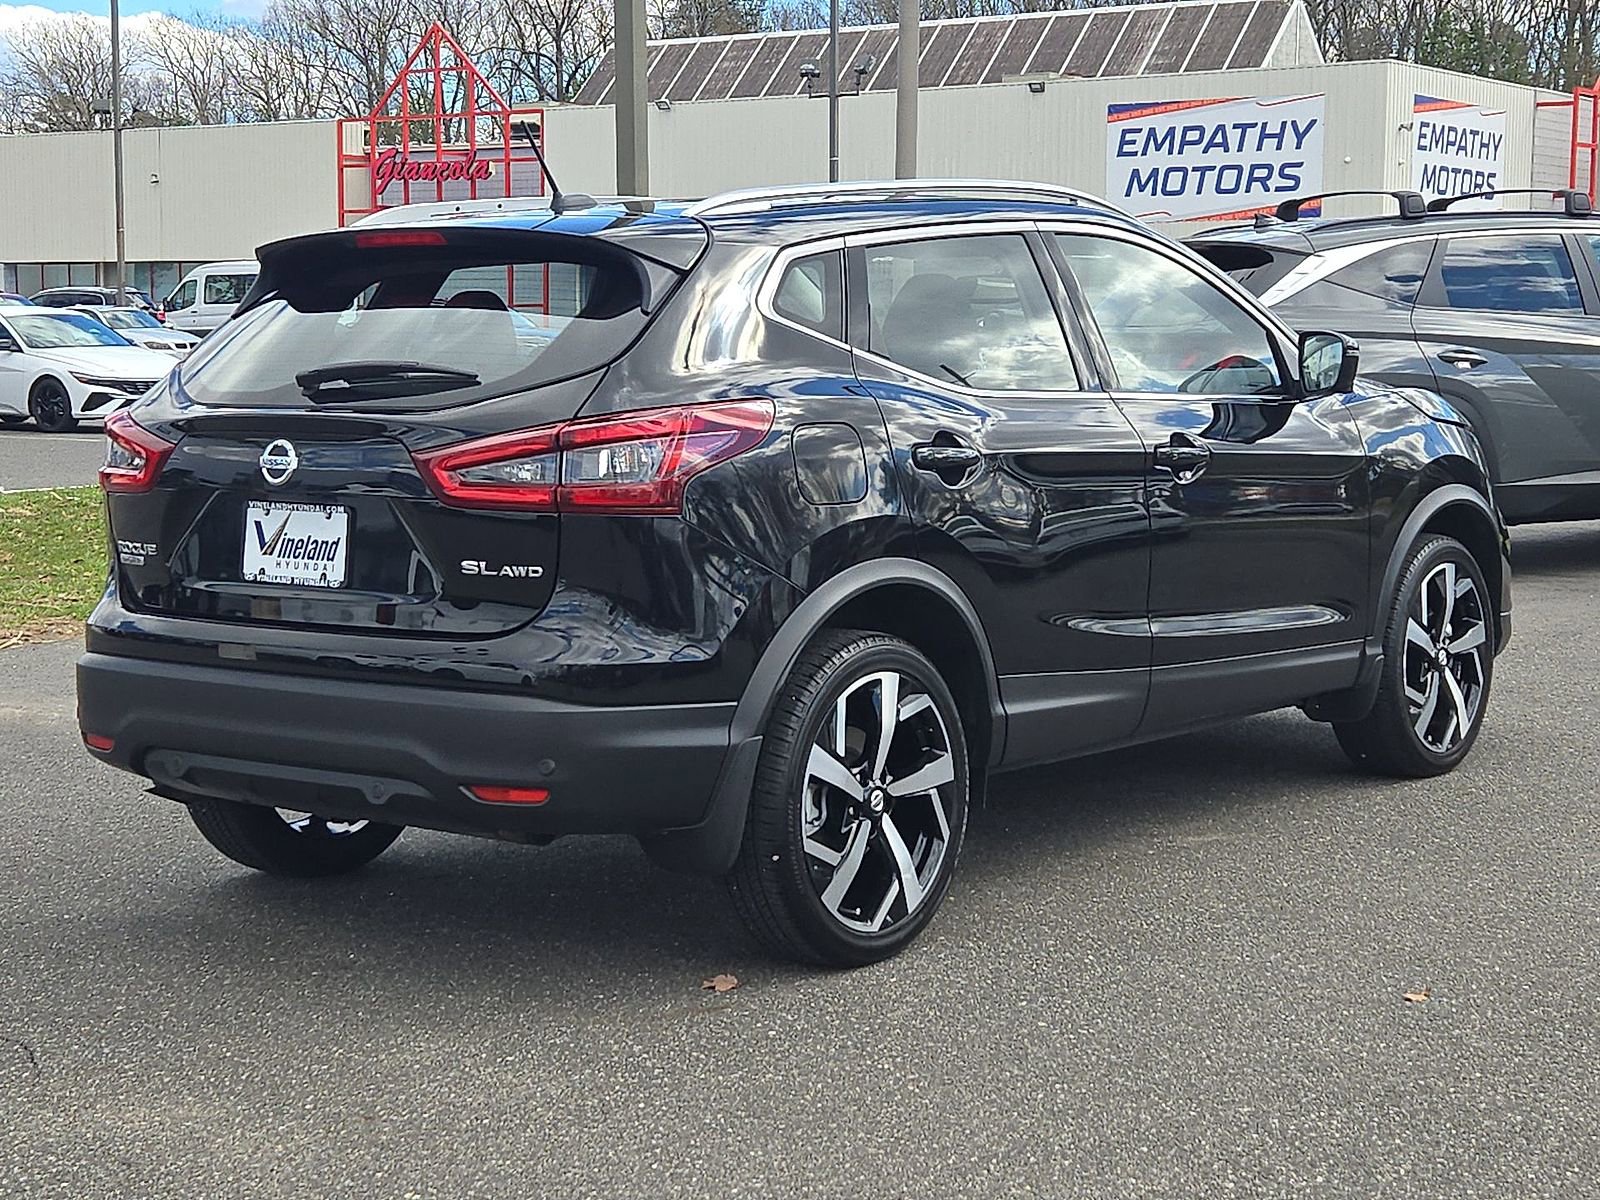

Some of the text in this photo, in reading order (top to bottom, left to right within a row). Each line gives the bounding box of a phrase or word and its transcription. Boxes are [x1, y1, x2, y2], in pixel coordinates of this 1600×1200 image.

[1116, 119, 1318, 158] EMPATHY
[1417, 120, 1502, 162] EMPATHY
[374, 148, 492, 194] Giancola
[1124, 161, 1305, 197] MOTORS
[1420, 163, 1497, 200] MOTORS
[254, 511, 341, 562] Vineland
[276, 560, 336, 573] HYUNDAI
[460, 560, 543, 578] SL AWD
